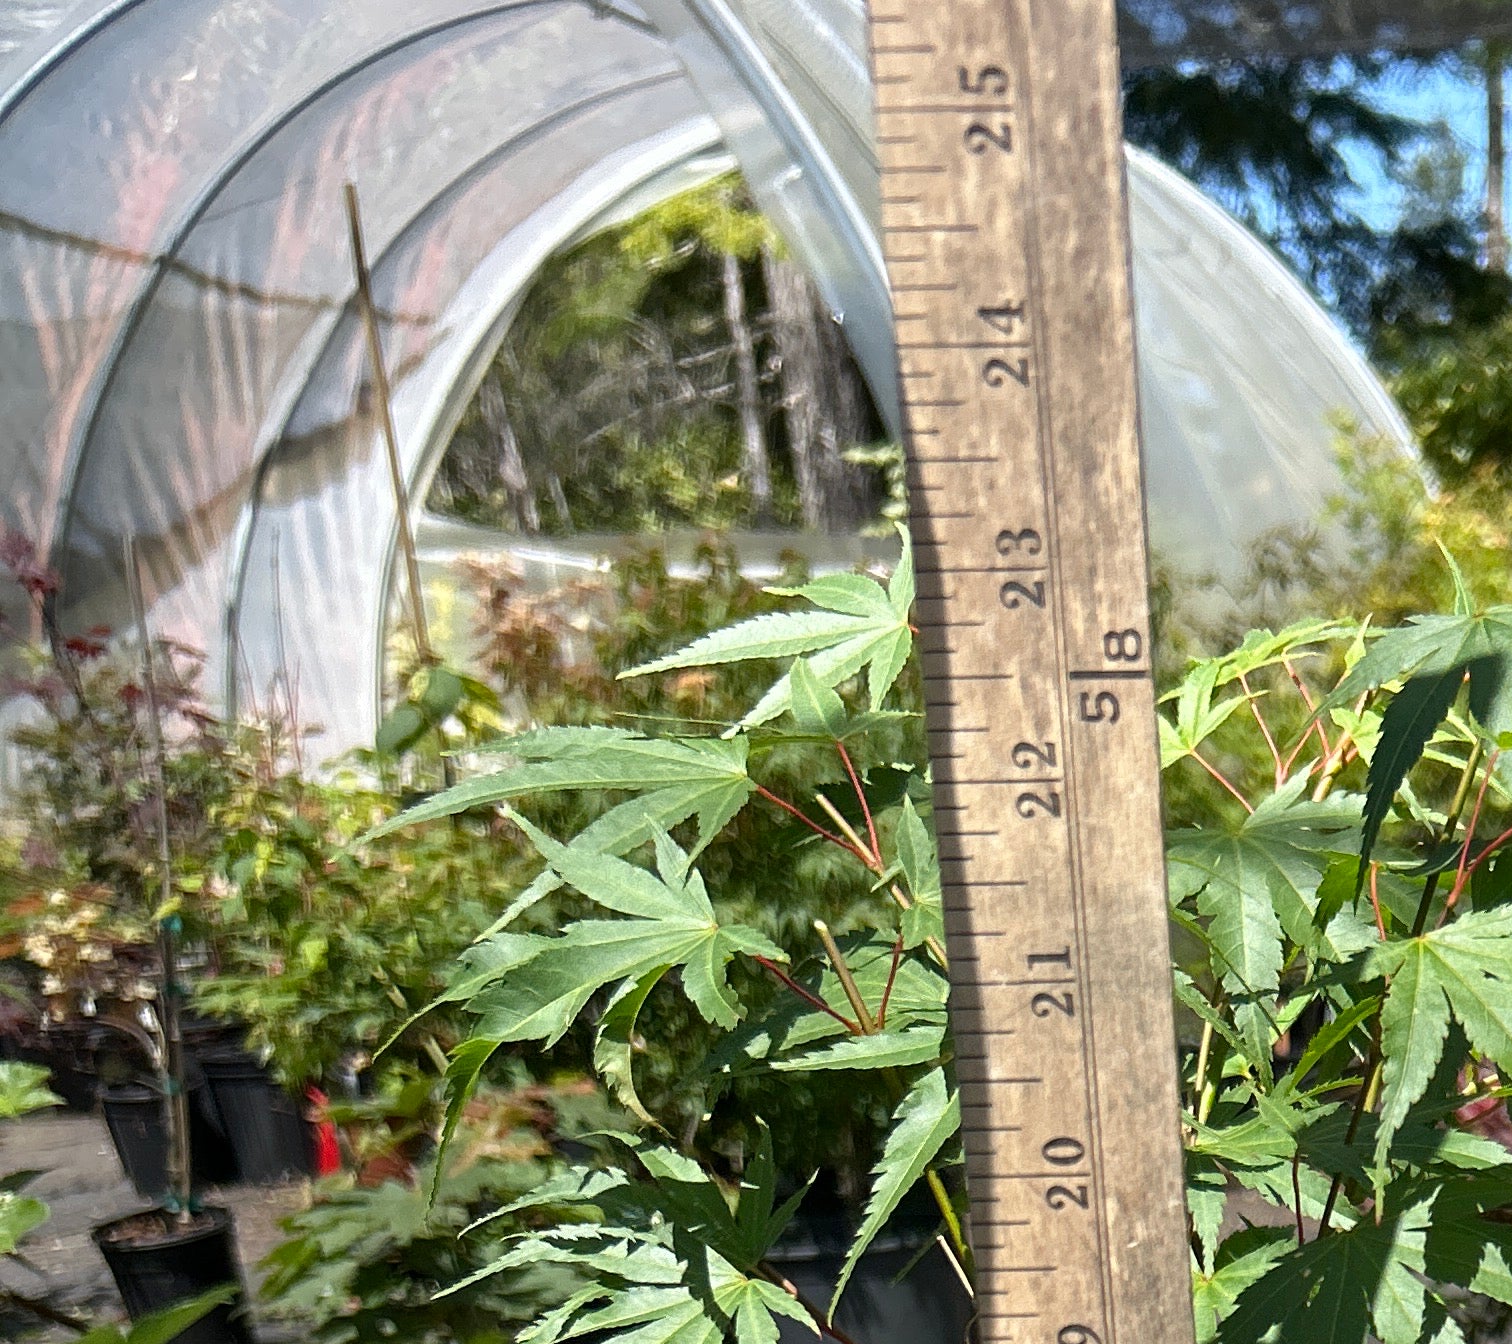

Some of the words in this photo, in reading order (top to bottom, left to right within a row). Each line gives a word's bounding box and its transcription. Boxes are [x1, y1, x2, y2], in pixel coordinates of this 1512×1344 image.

[959, 63, 1014, 156] 25
[978, 299, 1030, 389] 24
[995, 527, 1047, 610] 23
[1011, 740, 1062, 820] 22
[1027, 945, 1075, 1019] 21
[1042, 1136, 1089, 1211] 20
